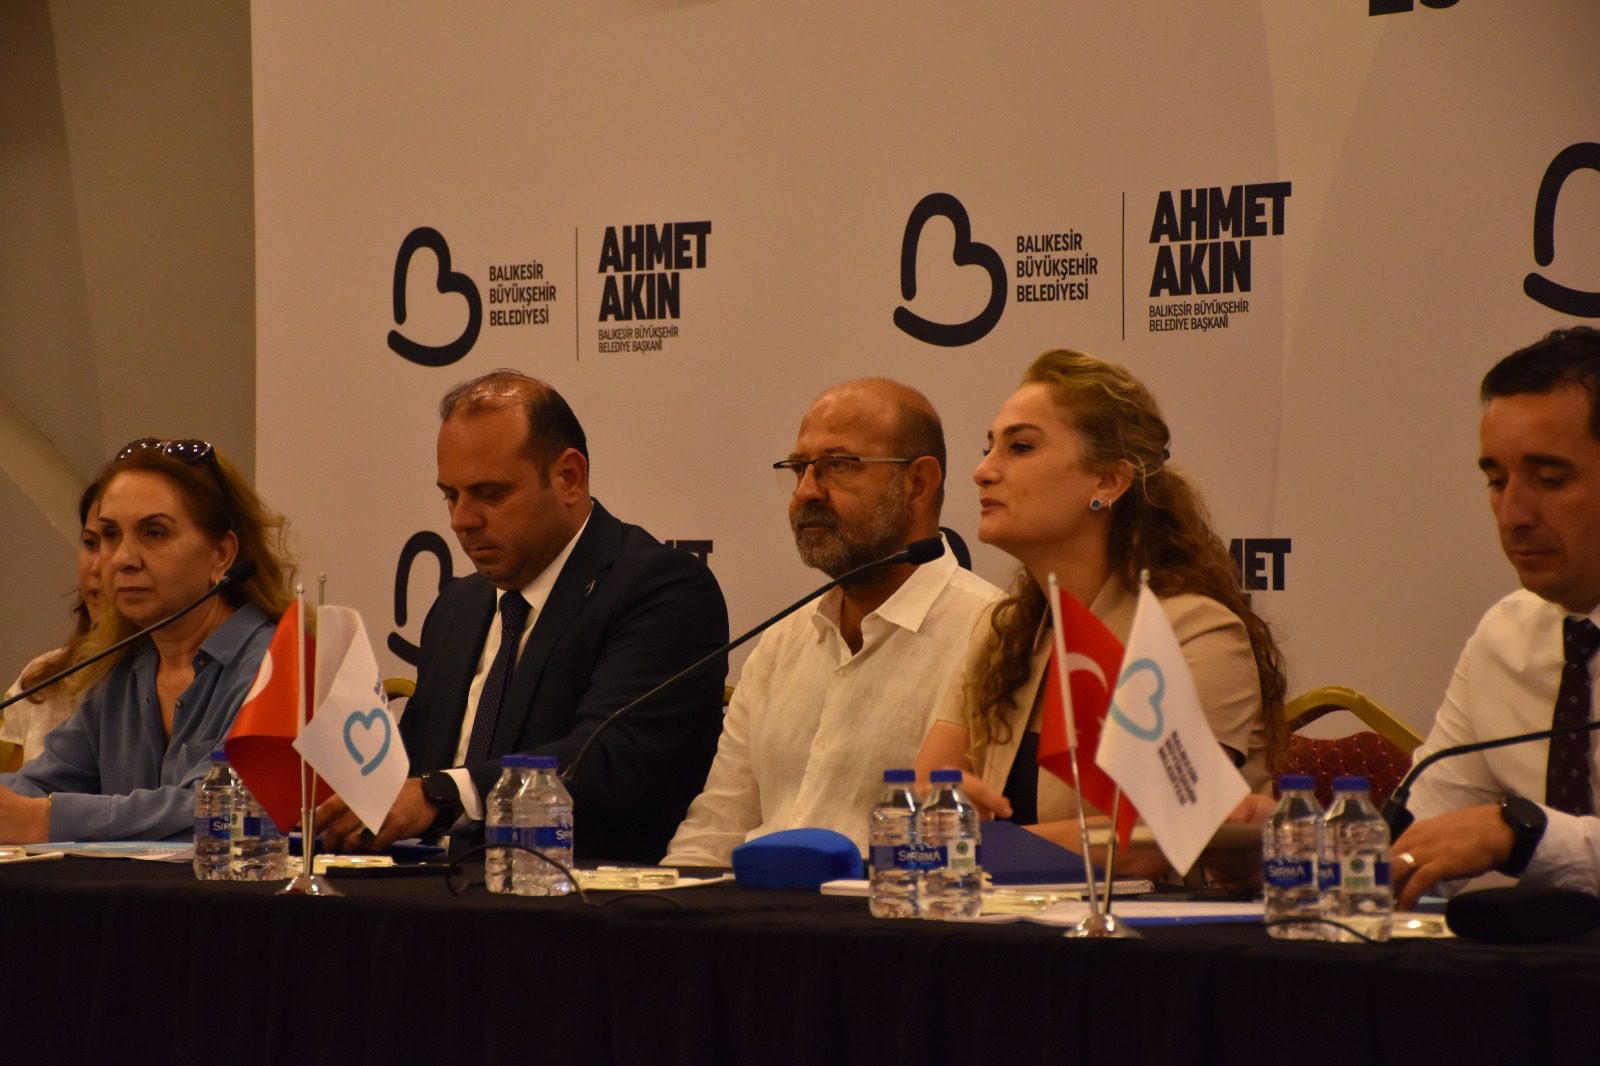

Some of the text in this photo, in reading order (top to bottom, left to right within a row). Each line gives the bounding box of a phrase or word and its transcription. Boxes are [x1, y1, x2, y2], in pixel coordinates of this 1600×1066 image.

[1148, 181, 1292, 244] AHMET
[598, 220, 712, 274] AHMET
[1016, 228, 1083, 253] BALIKESİR
[489, 259, 544, 282] BALIKESİR
[1016, 253, 1099, 280] BÜYÜKŞEHİR
[1148, 239, 1252, 298] AKIN
[489, 281, 557, 305] BÜYÜKŞEHİR
[598, 271, 681, 322] AKIN
[1016, 278, 1090, 303] BELEDİYESİ
[489, 304, 550, 327] BELEDİYESİ
[1149, 298, 1249, 318] BALIKESİR BÜYÜKŞEHİR
[598, 324, 679, 341] BALIKESİR BÜYÜKŞEHİR
[1149, 316, 1190, 332] BELEDİYE
[598, 338, 631, 353] BELEDİYE
